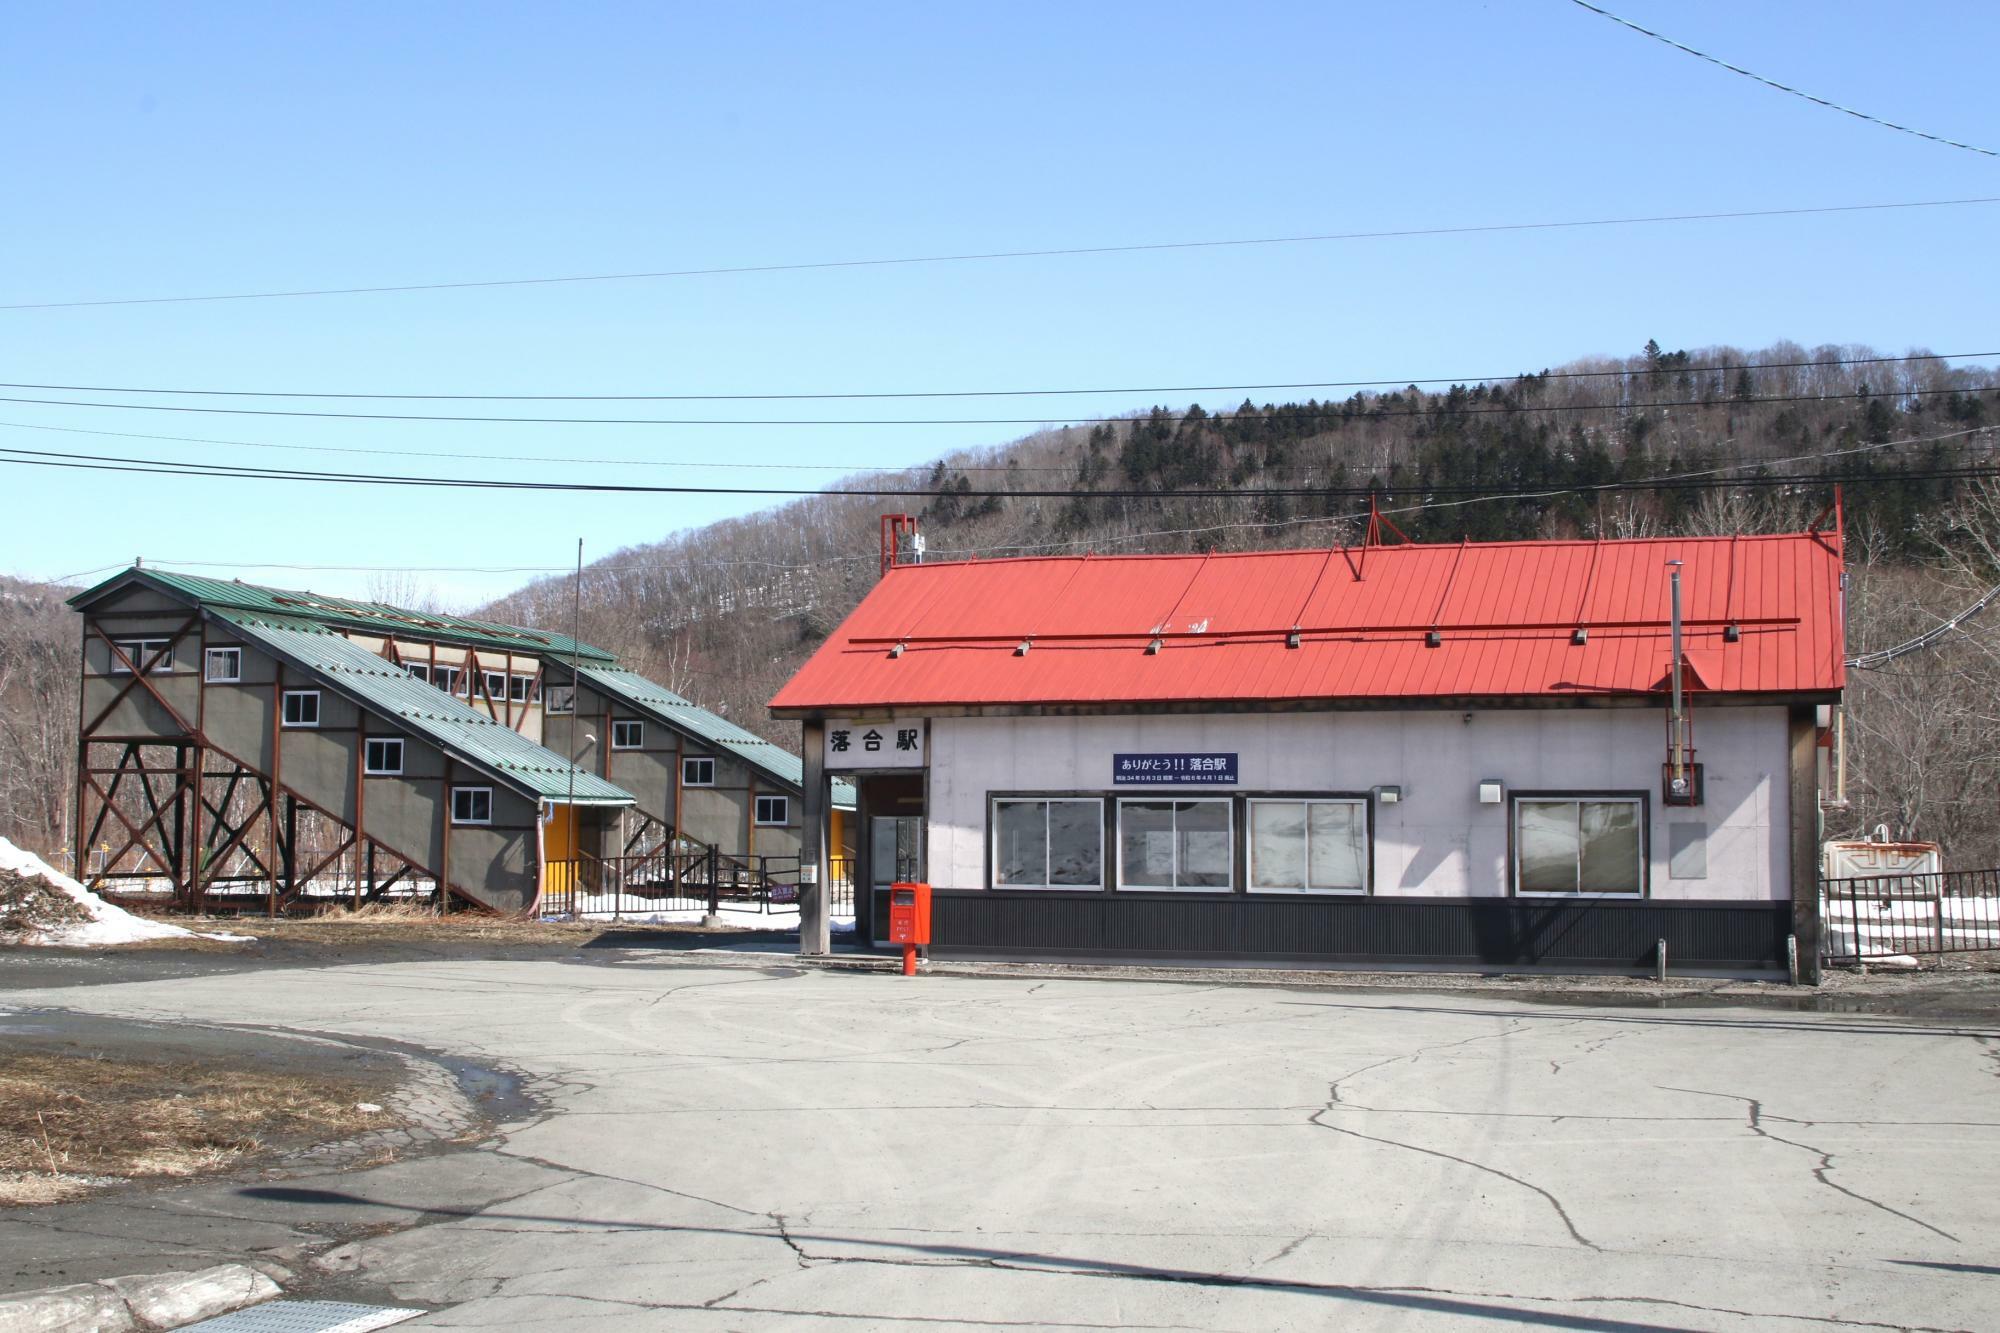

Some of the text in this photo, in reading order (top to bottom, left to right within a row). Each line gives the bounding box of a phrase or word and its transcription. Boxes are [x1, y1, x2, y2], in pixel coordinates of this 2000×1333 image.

[830, 729, 918, 752] 落合駅
[1190, 758, 1227, 771] 落合駅
